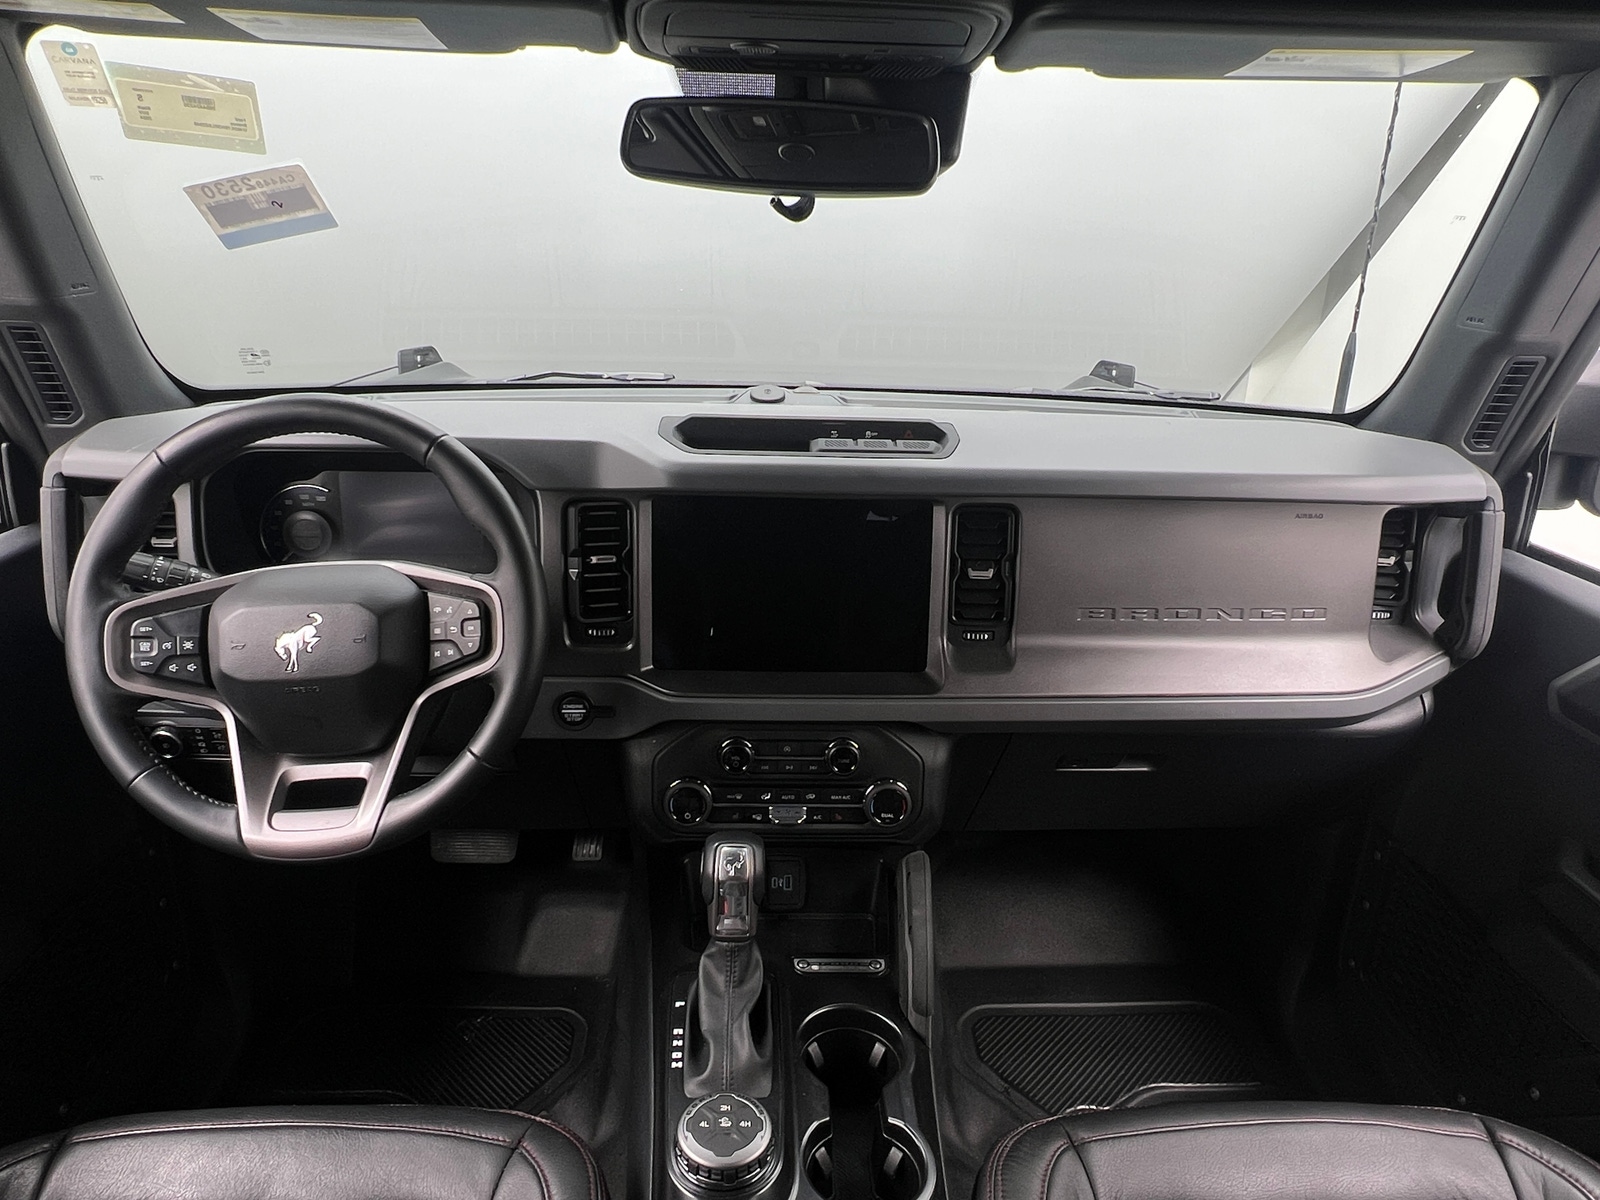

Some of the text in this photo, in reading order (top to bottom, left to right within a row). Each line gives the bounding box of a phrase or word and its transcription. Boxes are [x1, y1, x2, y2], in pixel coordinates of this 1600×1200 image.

[51, 55, 97, 65] CARVANA
[1076, 607, 1328, 622] BRONCO
[672, 1039, 683, 1047] N
[719, 1104, 731, 1112] 2H
[699, 1120, 710, 1128] 4L
[739, 1120, 752, 1128] 4H
